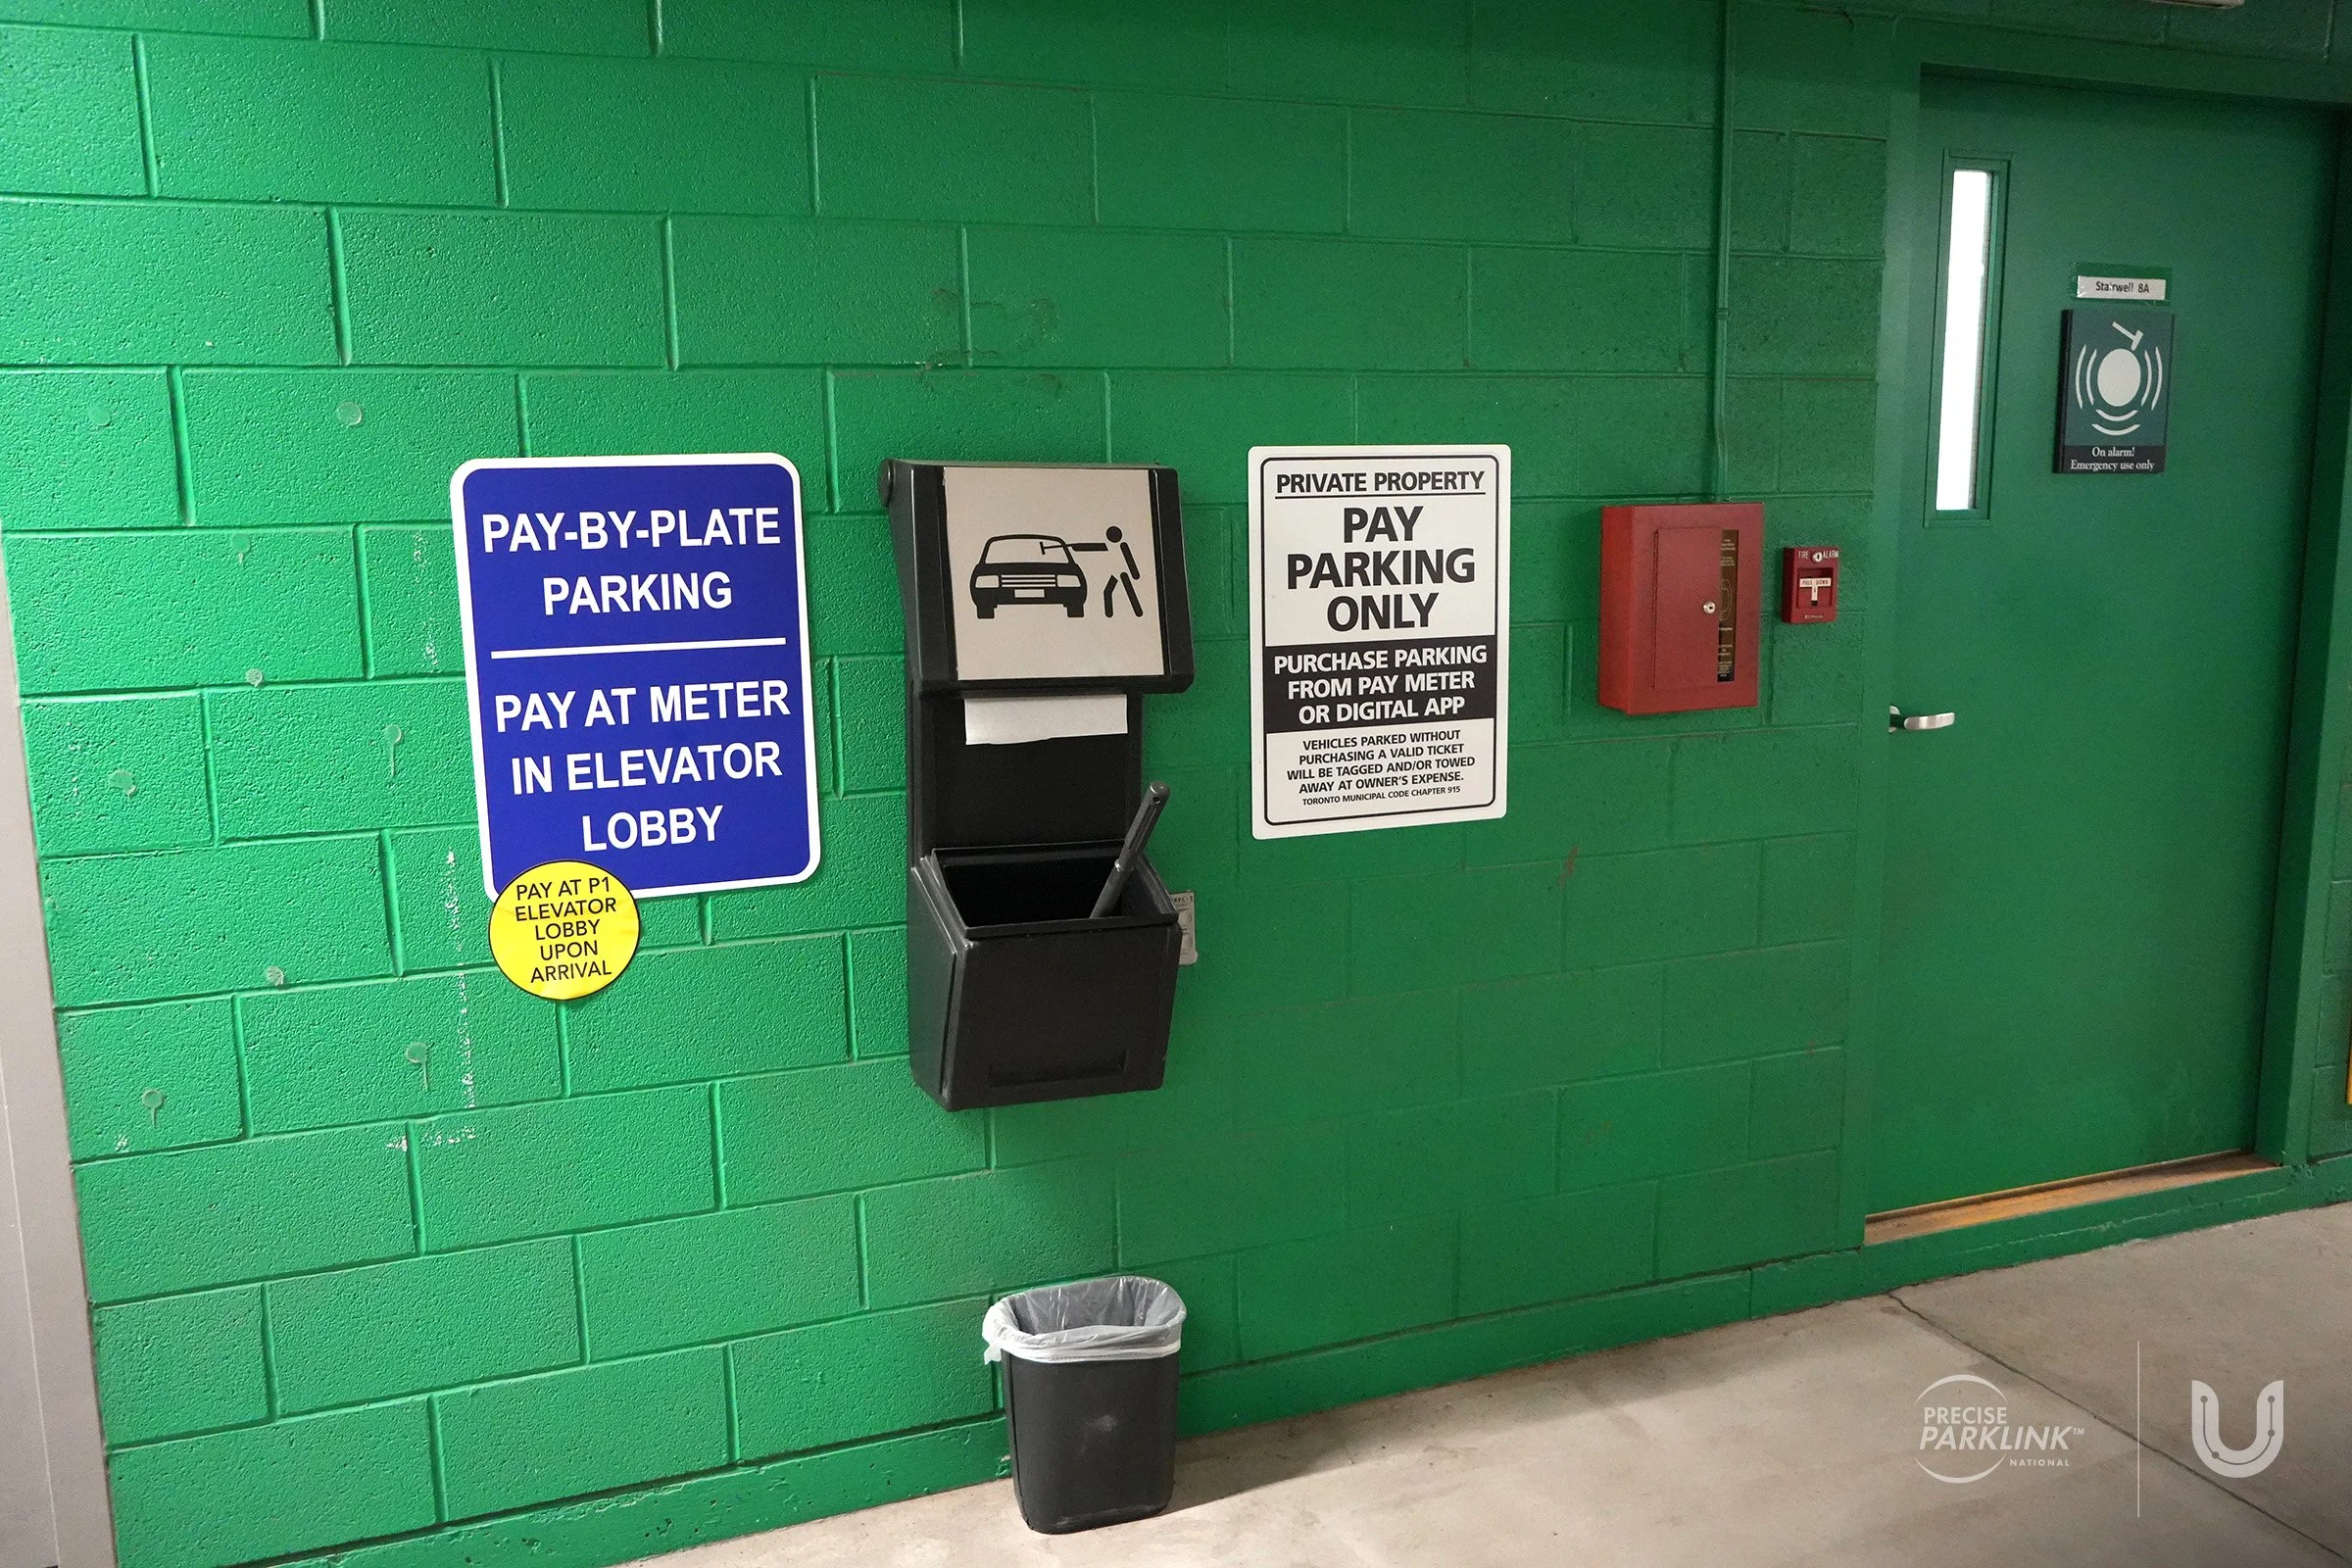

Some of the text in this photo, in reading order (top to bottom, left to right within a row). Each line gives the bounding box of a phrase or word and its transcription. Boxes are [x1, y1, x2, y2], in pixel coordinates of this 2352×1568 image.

[2138, 283, 2149, 293] 8A
[2092, 447, 2134, 457] On alarm!
[2071, 460, 2154, 471] Emergency use only
[1277, 470, 1485, 493] PRIVATE PROPERTY
[482, 508, 781, 553] PAY-BY-PLATE
[1344, 506, 1424, 543] PAY
[1288, 548, 1476, 590] PARKING
[543, 572, 732, 615] PARKING
[1327, 592, 1439, 632] ONLY
[1274, 645, 1488, 675] PURCHASE PARKING
[1288, 670, 1475, 700] FROM PAY METER
[495, 680, 791, 733] PAY AT METER
[1298, 697, 1465, 724] OR DIGITAL APP
[1302, 729, 1461, 751] VEHICLES PARKED WITHOUT
[1299, 743, 1464, 765] PURCHASING A VALID TICKET
[511, 741, 783, 795] IN ELEVATOR
[1287, 757, 1476, 780] WILL BE TAGGED AND/OR TOWED
[1298, 771, 1464, 794] AWAY AT OWNER'S EXPENSE.
[1302, 786, 1461, 806] TORONTO MUNICIPAL CODE CHAPTER 915
[582, 806, 724, 852] LOBBY
[516, 876, 610, 901] PAY AT P1
[514, 898, 616, 922] ELEVATOR
[535, 919, 601, 941] LOBBY
[540, 940, 599, 962] UPON
[530, 960, 612, 984] ARRIVAL
